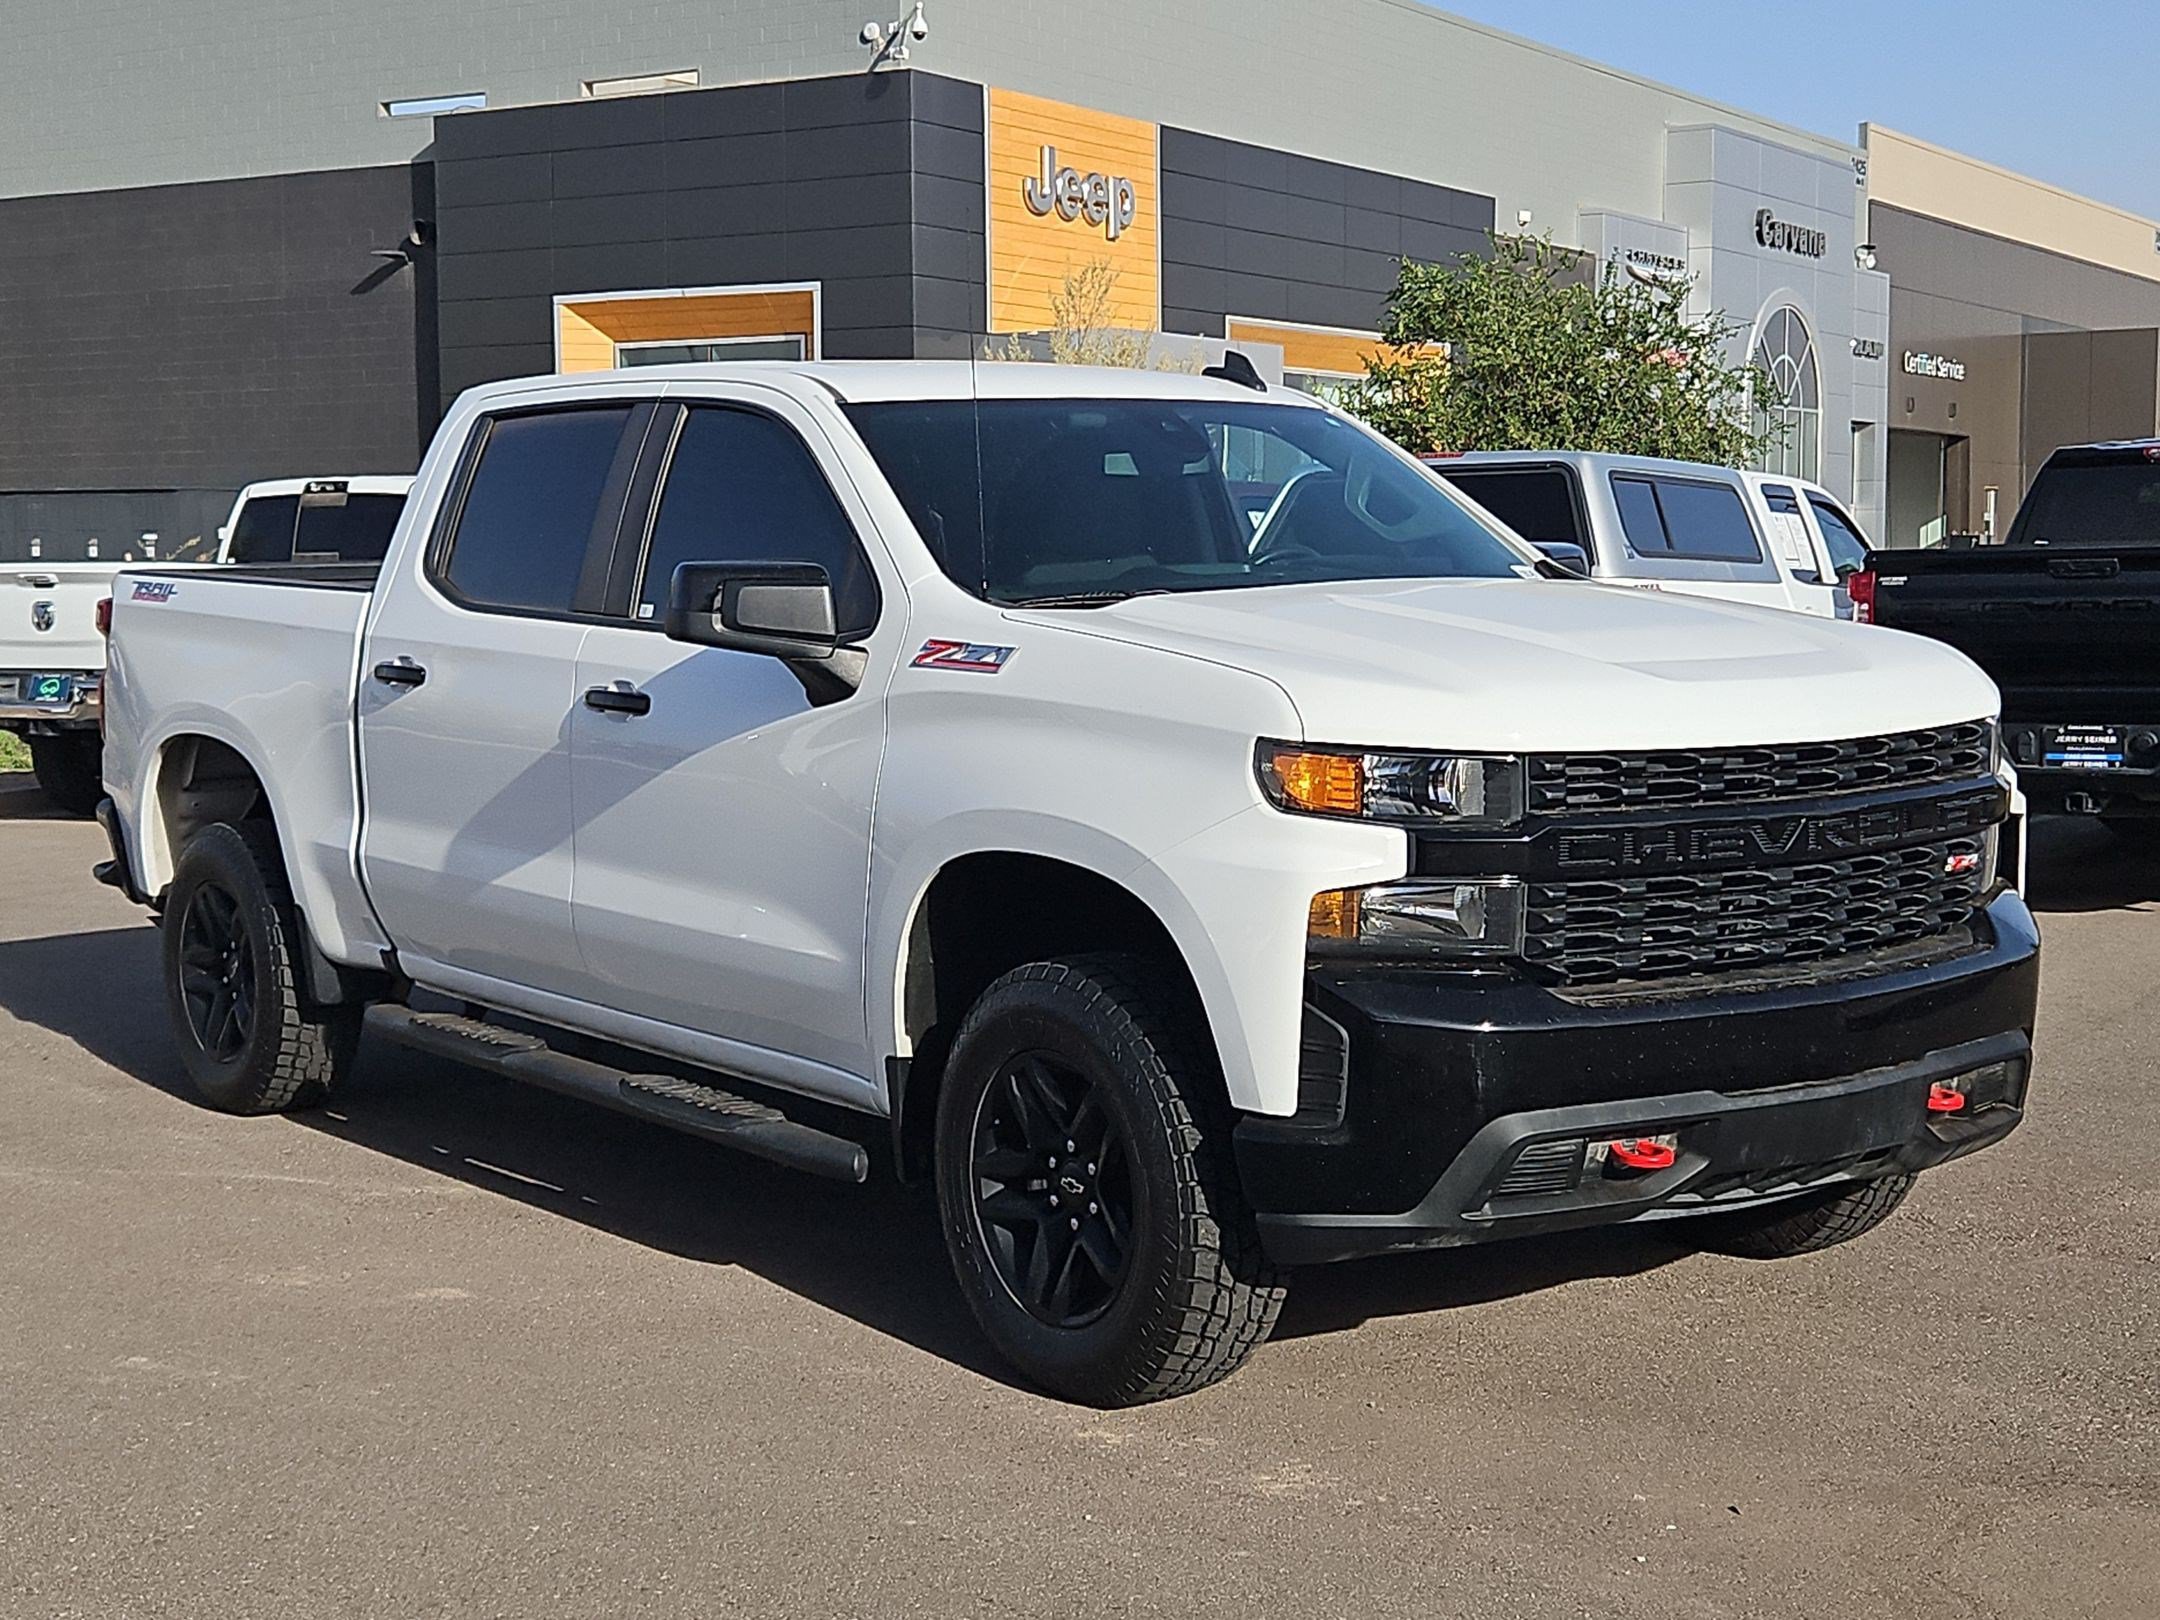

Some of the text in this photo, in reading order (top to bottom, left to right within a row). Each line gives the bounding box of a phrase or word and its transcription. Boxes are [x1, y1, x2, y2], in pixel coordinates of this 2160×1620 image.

[1022, 145, 1136, 241] Jeep
[1937, 355, 1965, 380] Service
[131, 580, 178, 597] TRAIL
[908, 638, 1018, 674] Z71
[2054, 735, 2117, 744] JERRY SEINER
[1558, 794, 1998, 868] CHEVROLET
